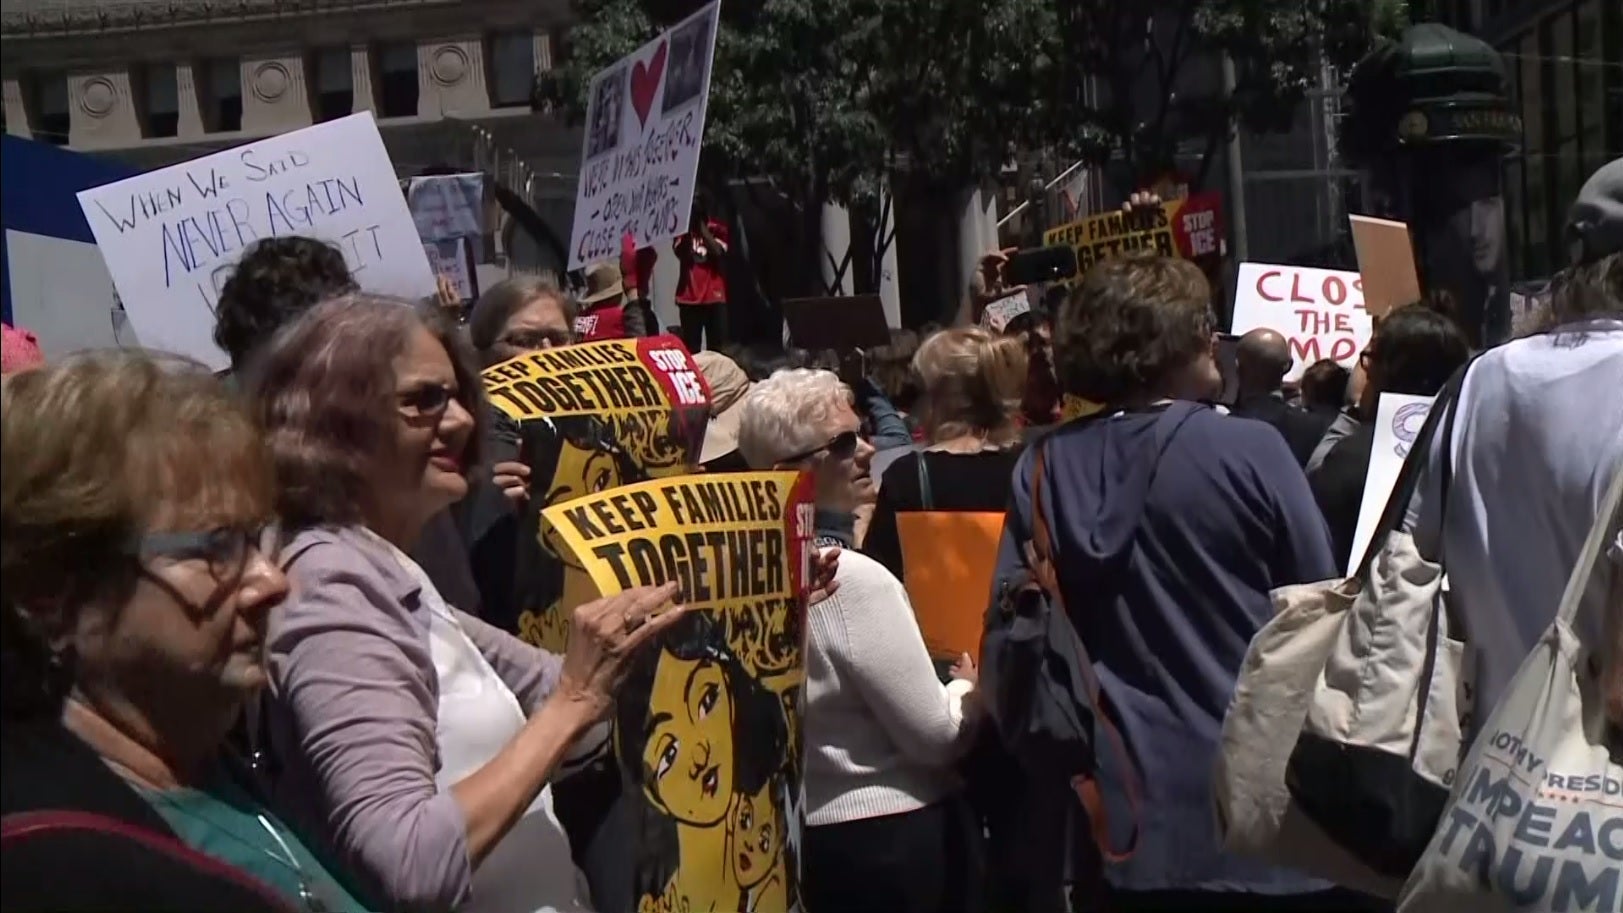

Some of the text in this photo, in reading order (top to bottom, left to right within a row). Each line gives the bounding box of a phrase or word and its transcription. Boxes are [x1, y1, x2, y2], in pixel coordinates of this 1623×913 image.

[95, 186, 181, 234] WHEN
[240, 150, 310, 182] SAID
[162, 198, 259, 288] NEVER
[265, 176, 365, 239] AGAIN
[1048, 207, 1168, 246] KEEP FAMIS
[1183, 209, 1214, 233] STOP
[1077, 231, 1173, 273] GETHER
[1190, 231, 1216, 257] ICE
[1256, 271, 1366, 309] CLOS
[1294, 309, 1355, 335] THE
[529, 342, 637, 374] FAMILIES
[648, 348, 687, 372] STOP
[488, 364, 662, 415] TOGETHER
[667, 371, 707, 405] ICE
[562, 480, 782, 541] KEEP FAMILIES
[592, 527, 784, 606] TOGETHER
